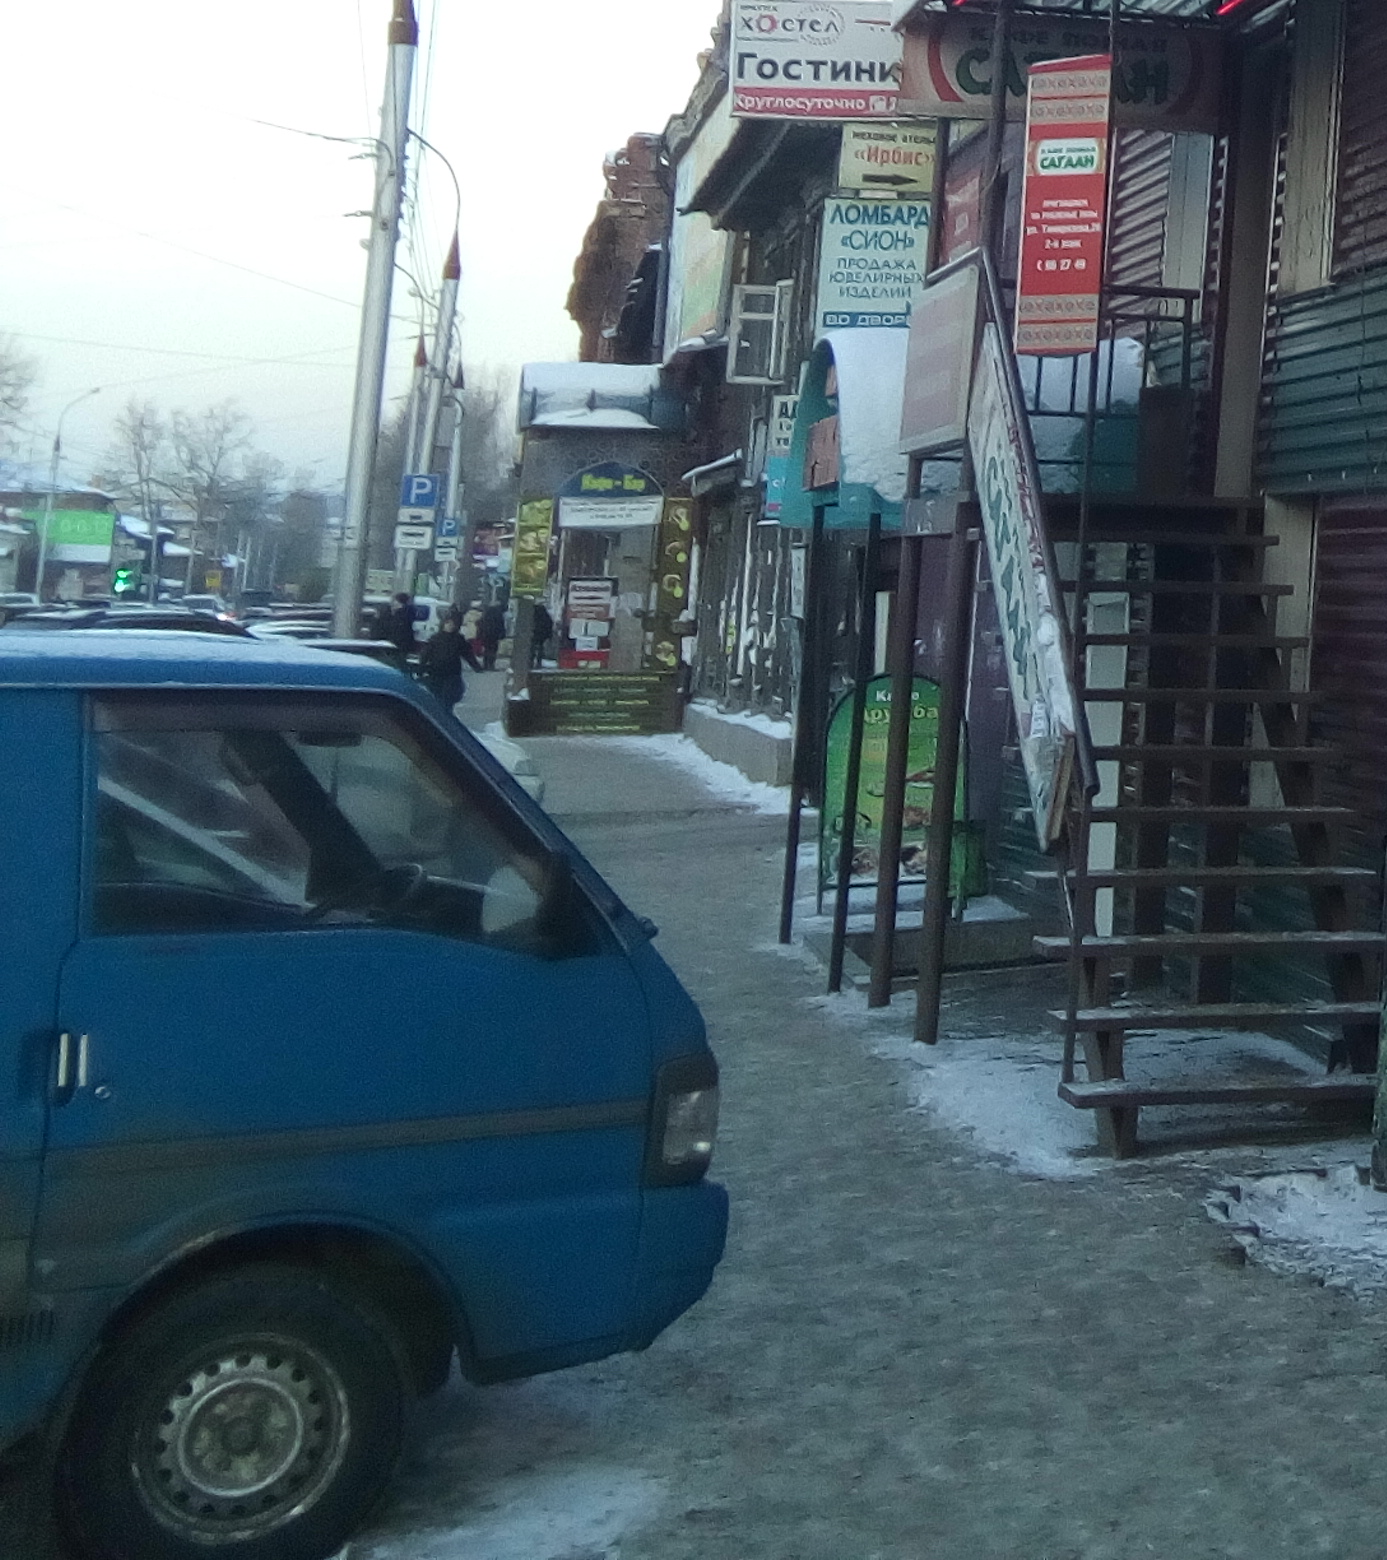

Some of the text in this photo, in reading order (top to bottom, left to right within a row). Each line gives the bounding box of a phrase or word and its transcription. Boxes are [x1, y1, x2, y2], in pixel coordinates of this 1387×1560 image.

[829, 204, 929, 229] ЛОМБАРД
[837, 257, 917, 271] ПРОДАЖА
[829, 271, 925, 284] ЮВЕЛИРНЫХ
[857, 314, 908, 327] ДВОР
